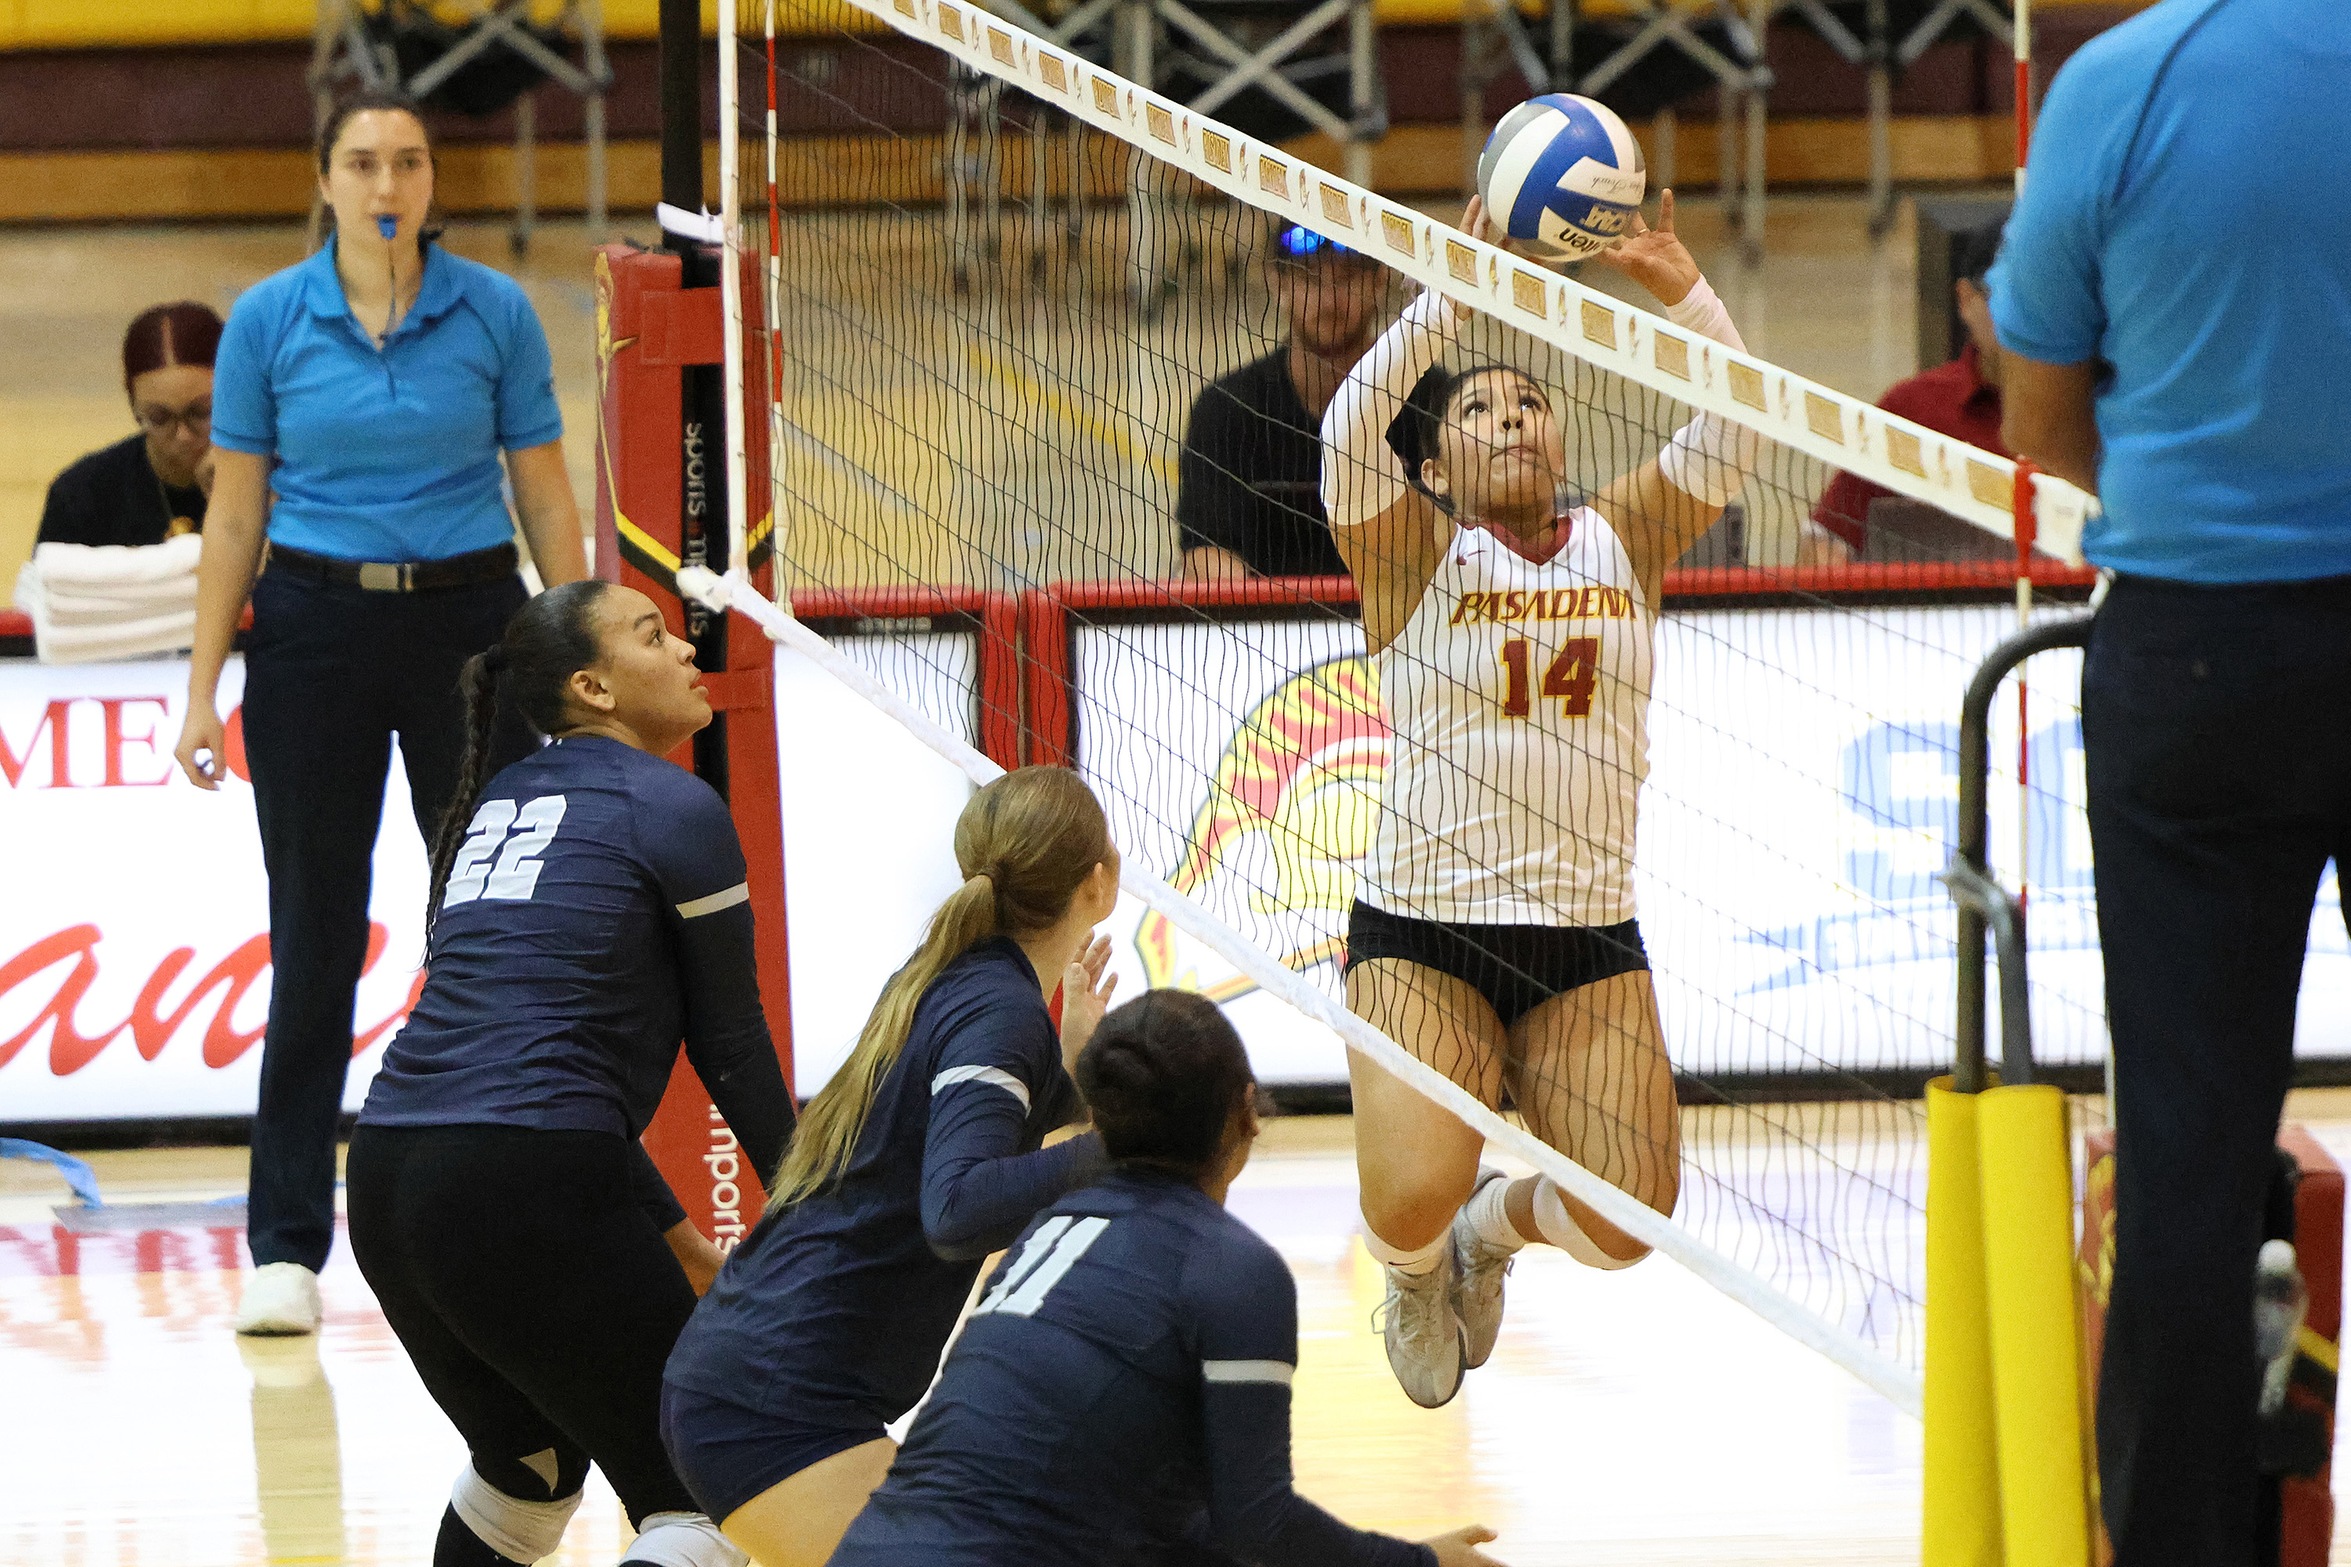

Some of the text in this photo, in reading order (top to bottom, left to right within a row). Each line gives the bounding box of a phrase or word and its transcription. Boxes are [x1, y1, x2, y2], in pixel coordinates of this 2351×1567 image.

[1449, 586, 1637, 627] PASADENA
[1502, 635, 1601, 719] 14
[442, 794, 566, 909] 22
